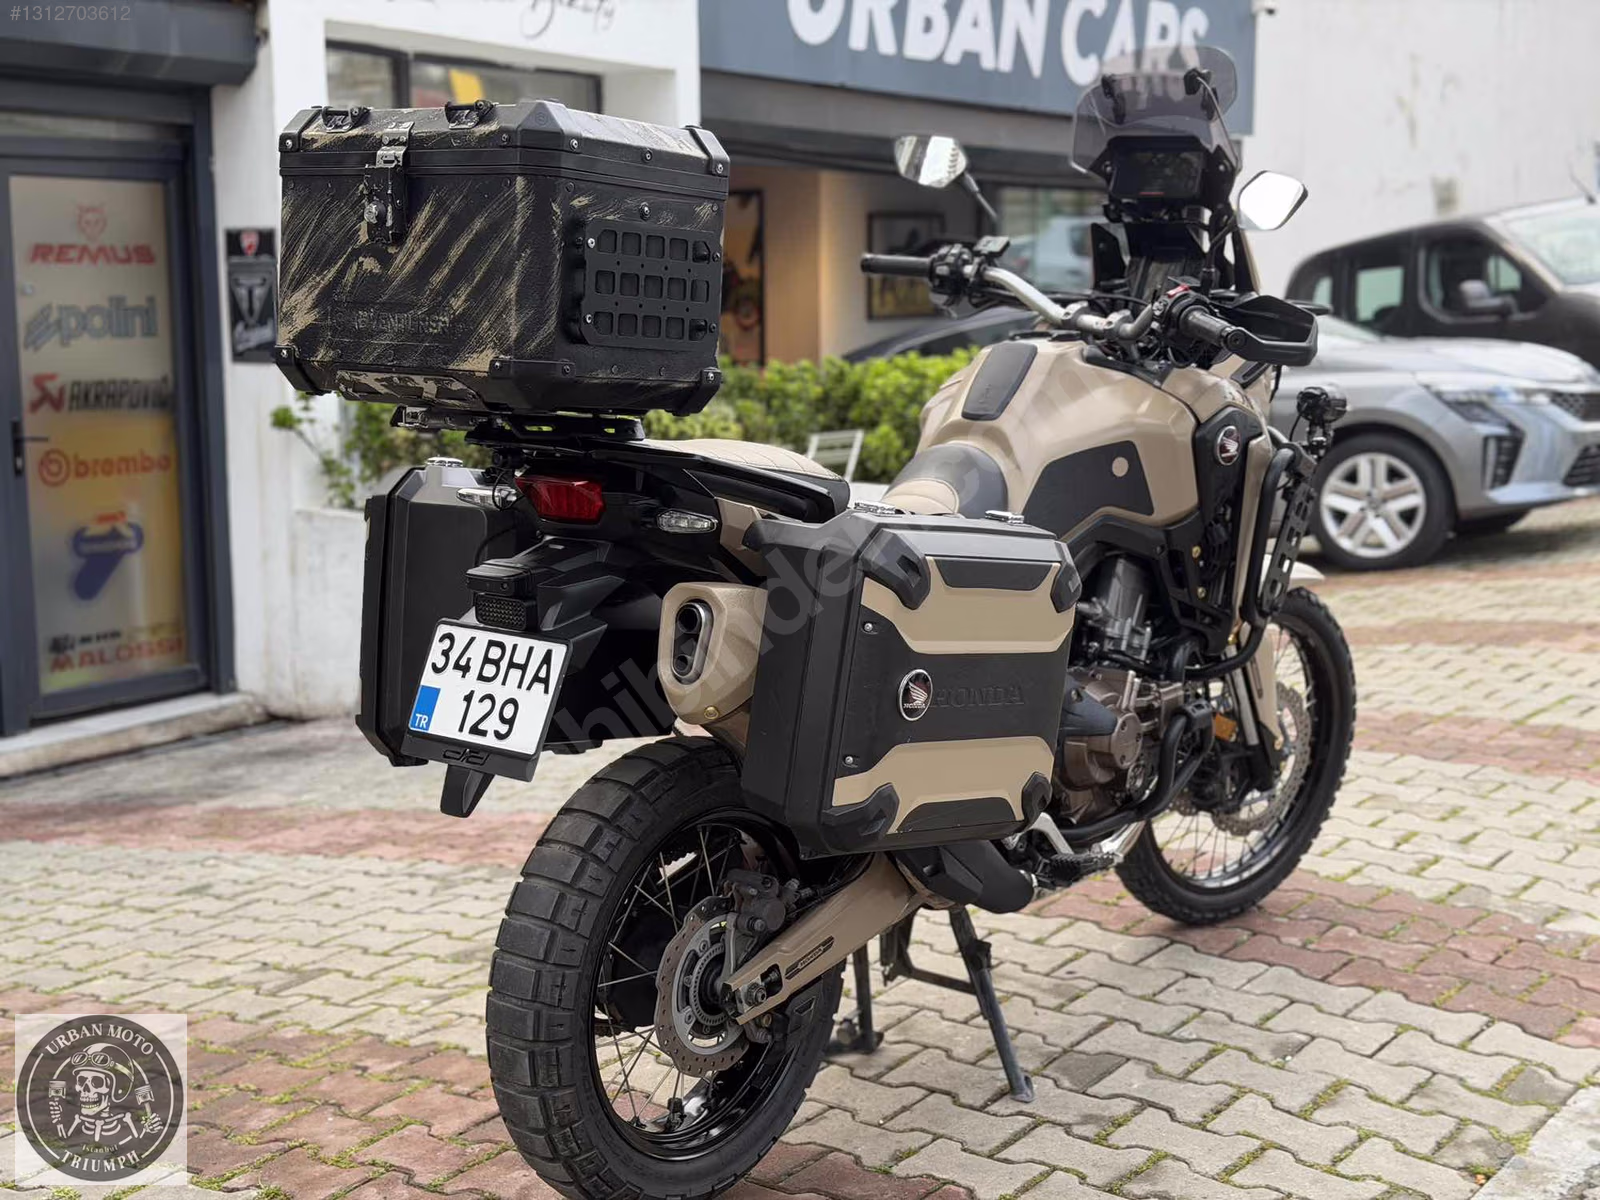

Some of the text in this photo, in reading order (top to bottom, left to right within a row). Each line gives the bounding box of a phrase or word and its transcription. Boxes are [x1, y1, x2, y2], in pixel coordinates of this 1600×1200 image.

[29, 243, 156, 265] REMUS
[57, 295, 158, 347] polini
[930, 686, 1025, 709] HONDA
[415, 713, 429, 729] TR
[458, 689, 519, 741] 129
